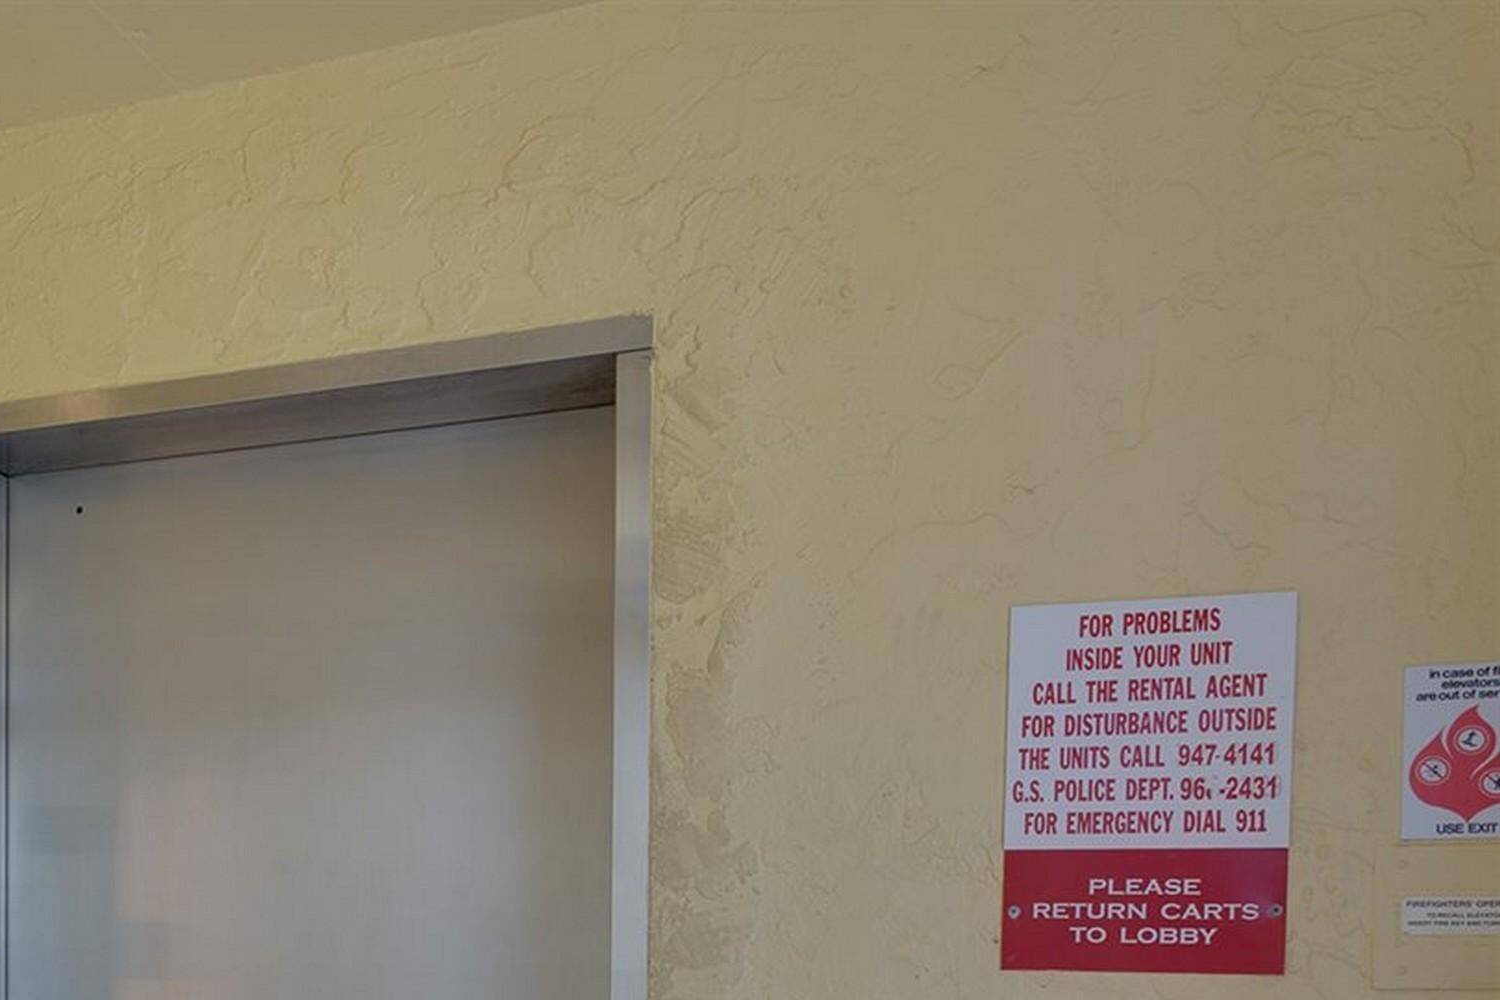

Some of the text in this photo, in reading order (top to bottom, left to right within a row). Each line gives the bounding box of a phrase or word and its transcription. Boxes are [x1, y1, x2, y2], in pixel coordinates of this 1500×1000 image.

[1079, 607, 1221, 638] FOR PROBLEMS
[1066, 641, 1233, 671] INSIDE YOUR UNIT
[1442, 668, 1474, 679] case
[1476, 666, 1490, 677] of
[1033, 673, 1267, 704] CALL THE RENTAL AGENT
[1438, 690, 1460, 701] out
[1462, 689, 1476, 699] of
[1022, 706, 1277, 738] FOR DISTURBANCE OUTSIDE
[1019, 743, 1275, 770] THE UNITS CALL 947-4141
[1013, 780, 1044, 802] G.S.
[1054, 779, 1116, 802] POLICE
[1126, 777, 1174, 801] DEPT.
[1024, 809, 1267, 834] FOR EMERGENCY DIAL 911
[1436, 822, 1498, 834] USE EXIT
[1089, 878, 1202, 895] PLEASE
[1033, 903, 1260, 920] RETURN CARTS
[1070, 926, 1219, 945] TO LOBBY
